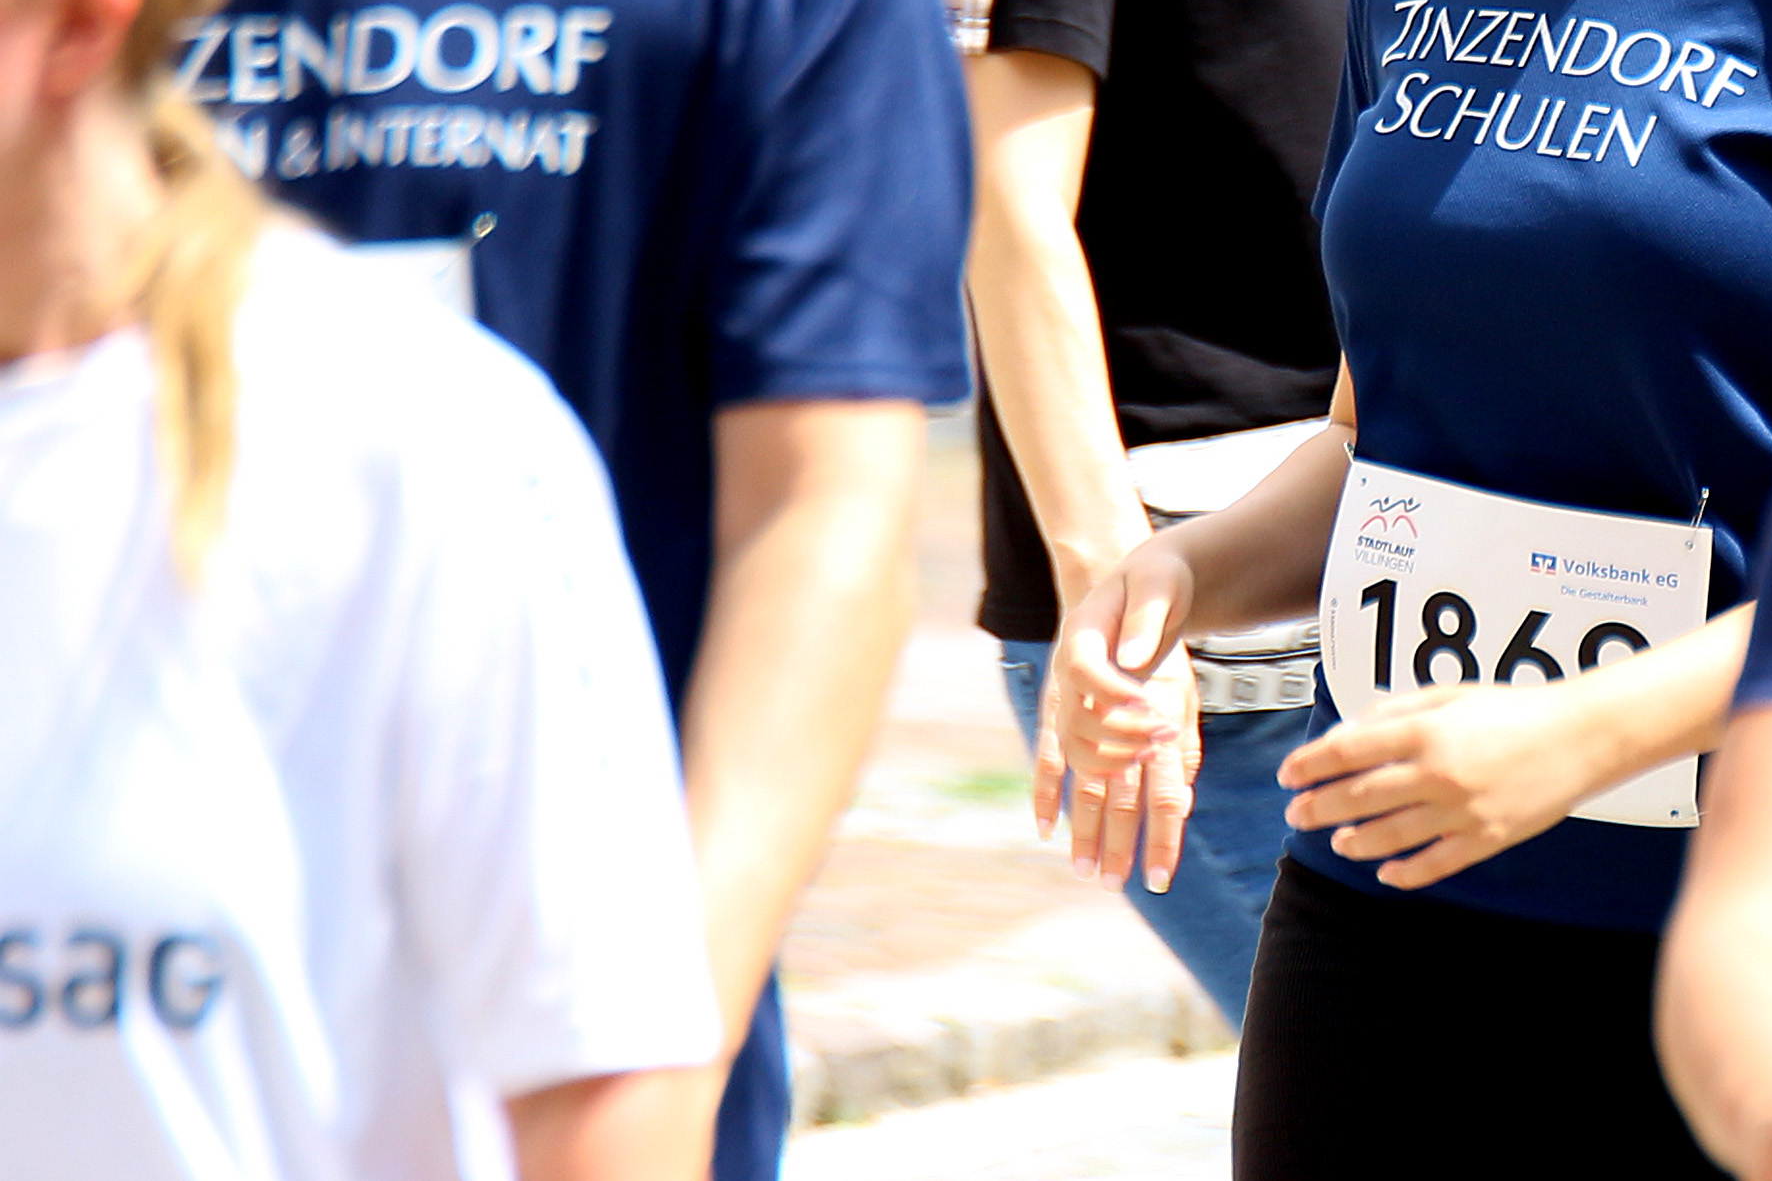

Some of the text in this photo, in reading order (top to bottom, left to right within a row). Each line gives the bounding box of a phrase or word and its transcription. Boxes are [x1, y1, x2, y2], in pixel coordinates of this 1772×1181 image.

[1374, 71, 1657, 168] SCHULEN
[324, 104, 599, 176] INTERNAT
[1357, 535, 1416, 559] STADTLAUF
[1354, 548, 1414, 574] VILLINGEN
[1563, 559, 1679, 588] Volksbank eG
[1560, 584, 1649, 606] Die Gestalterbank
